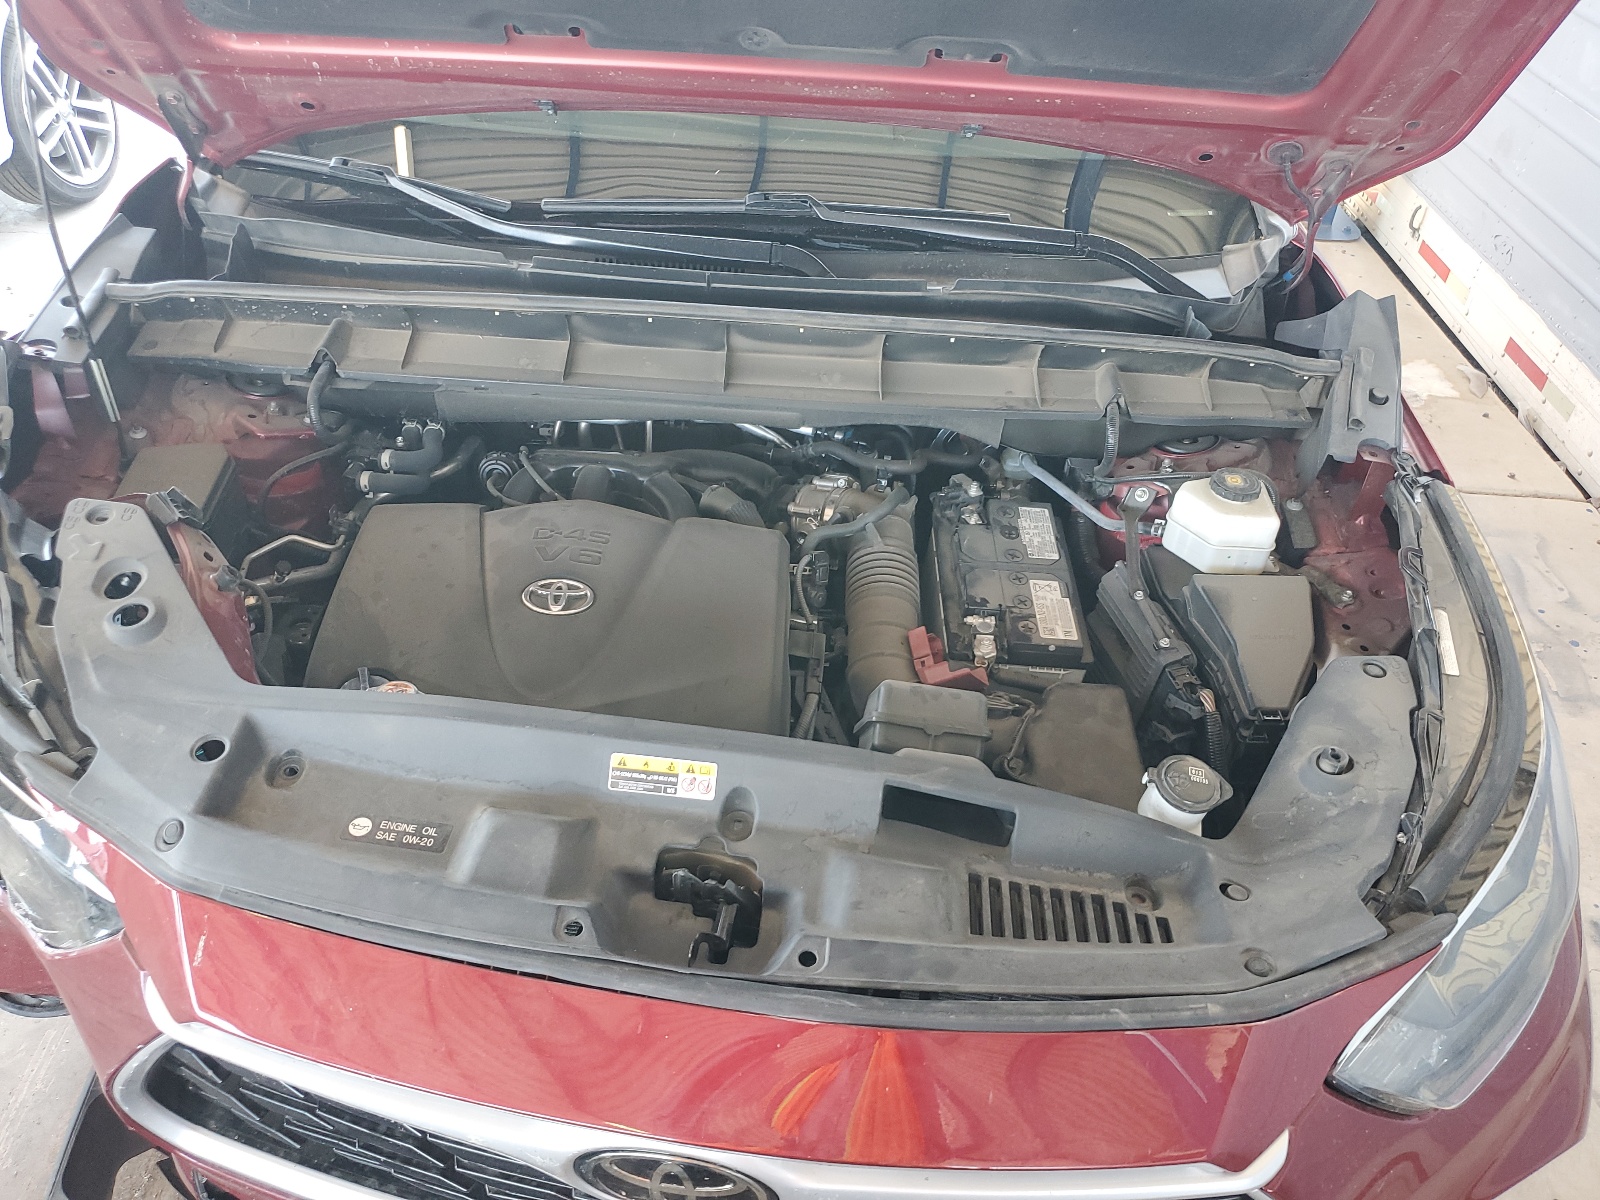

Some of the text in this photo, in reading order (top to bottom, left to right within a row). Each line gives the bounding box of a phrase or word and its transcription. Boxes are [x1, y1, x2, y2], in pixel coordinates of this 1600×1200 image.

[532, 526, 611, 545] D-4S
[535, 545, 603, 566] V6
[379, 820, 438, 837] ENGINE OIL
[375, 830, 434, 847] SAE 0W-20
